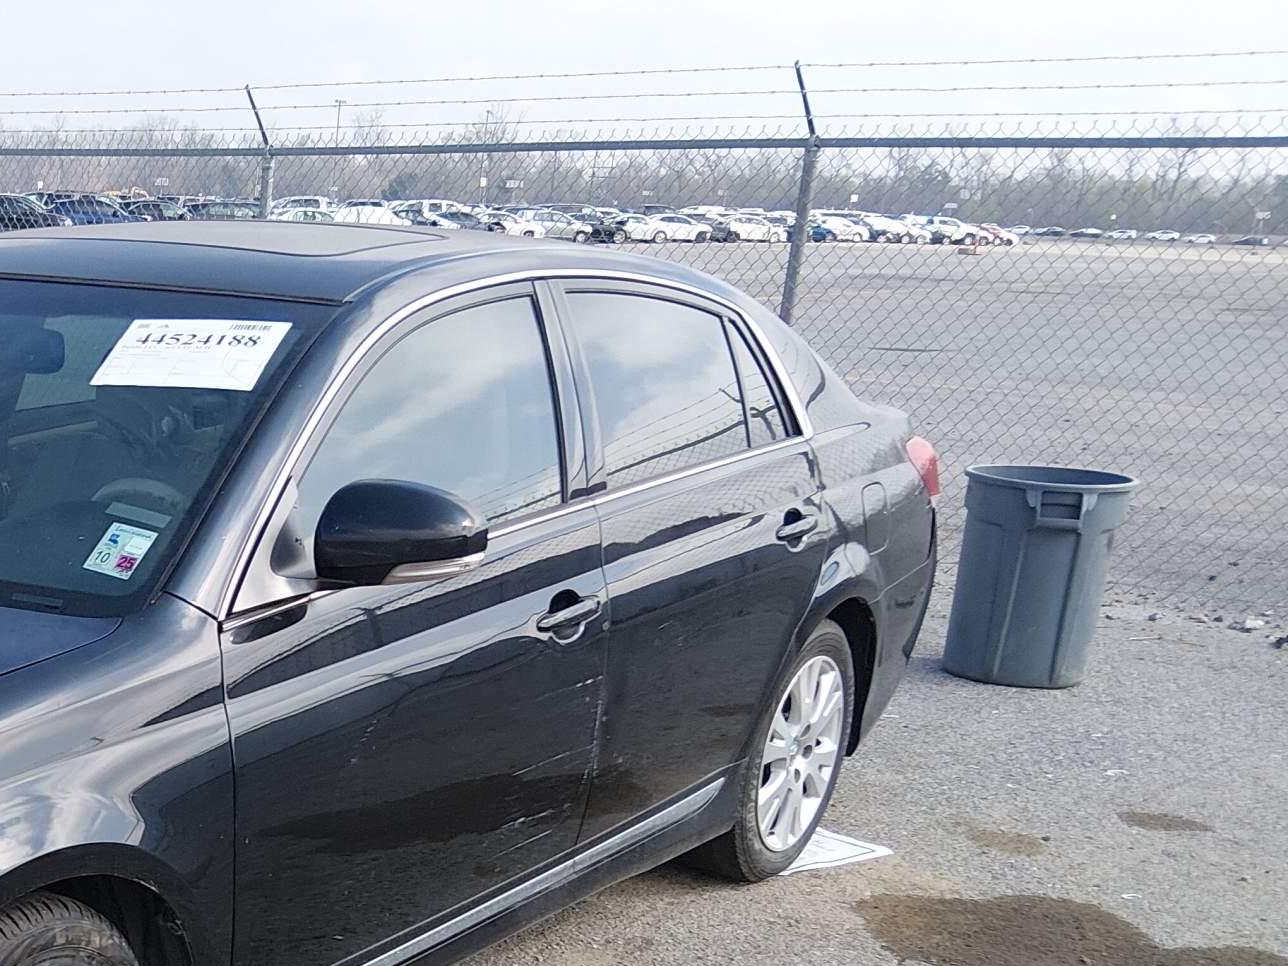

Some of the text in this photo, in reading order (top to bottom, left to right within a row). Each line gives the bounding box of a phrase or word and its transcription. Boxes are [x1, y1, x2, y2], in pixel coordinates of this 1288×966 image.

[137, 333, 260, 348] 44524188
[96, 551, 111, 563] 10
[118, 557, 136, 569] 25
